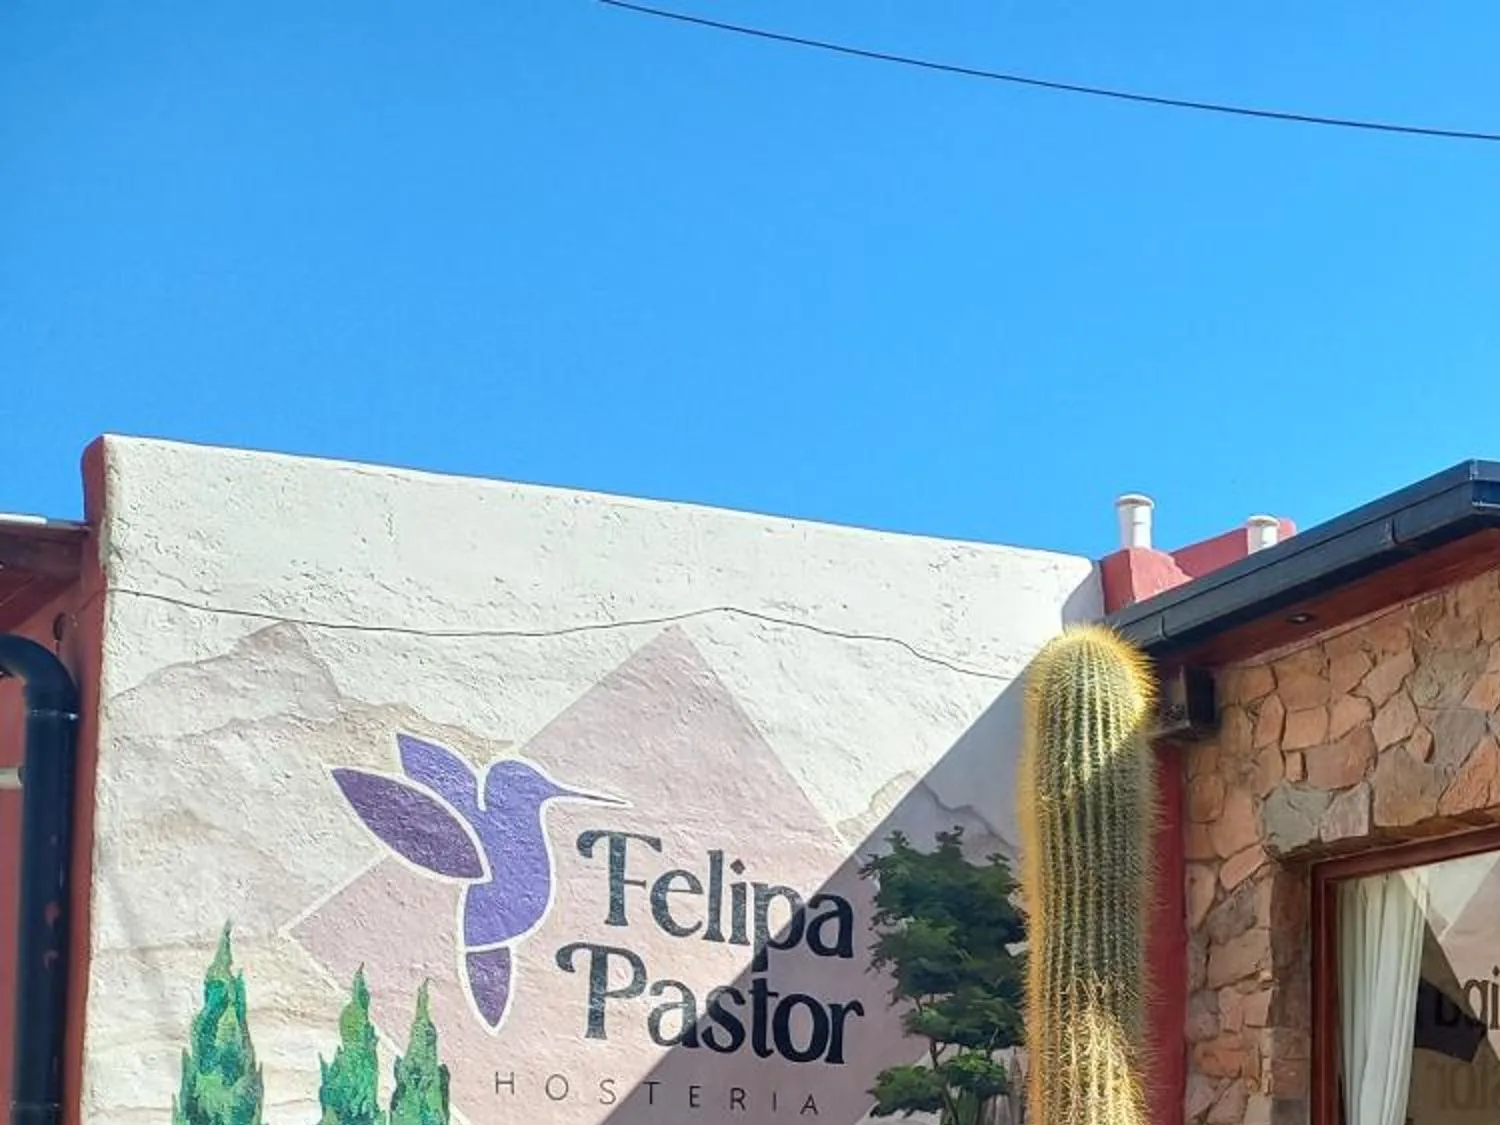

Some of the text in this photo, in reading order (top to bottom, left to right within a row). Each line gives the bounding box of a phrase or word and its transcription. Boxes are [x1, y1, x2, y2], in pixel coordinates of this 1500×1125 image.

[576, 829, 854, 972] Felipa
[555, 941, 864, 1064] Pastor
[494, 1071, 819, 1116] HOSTERIA
